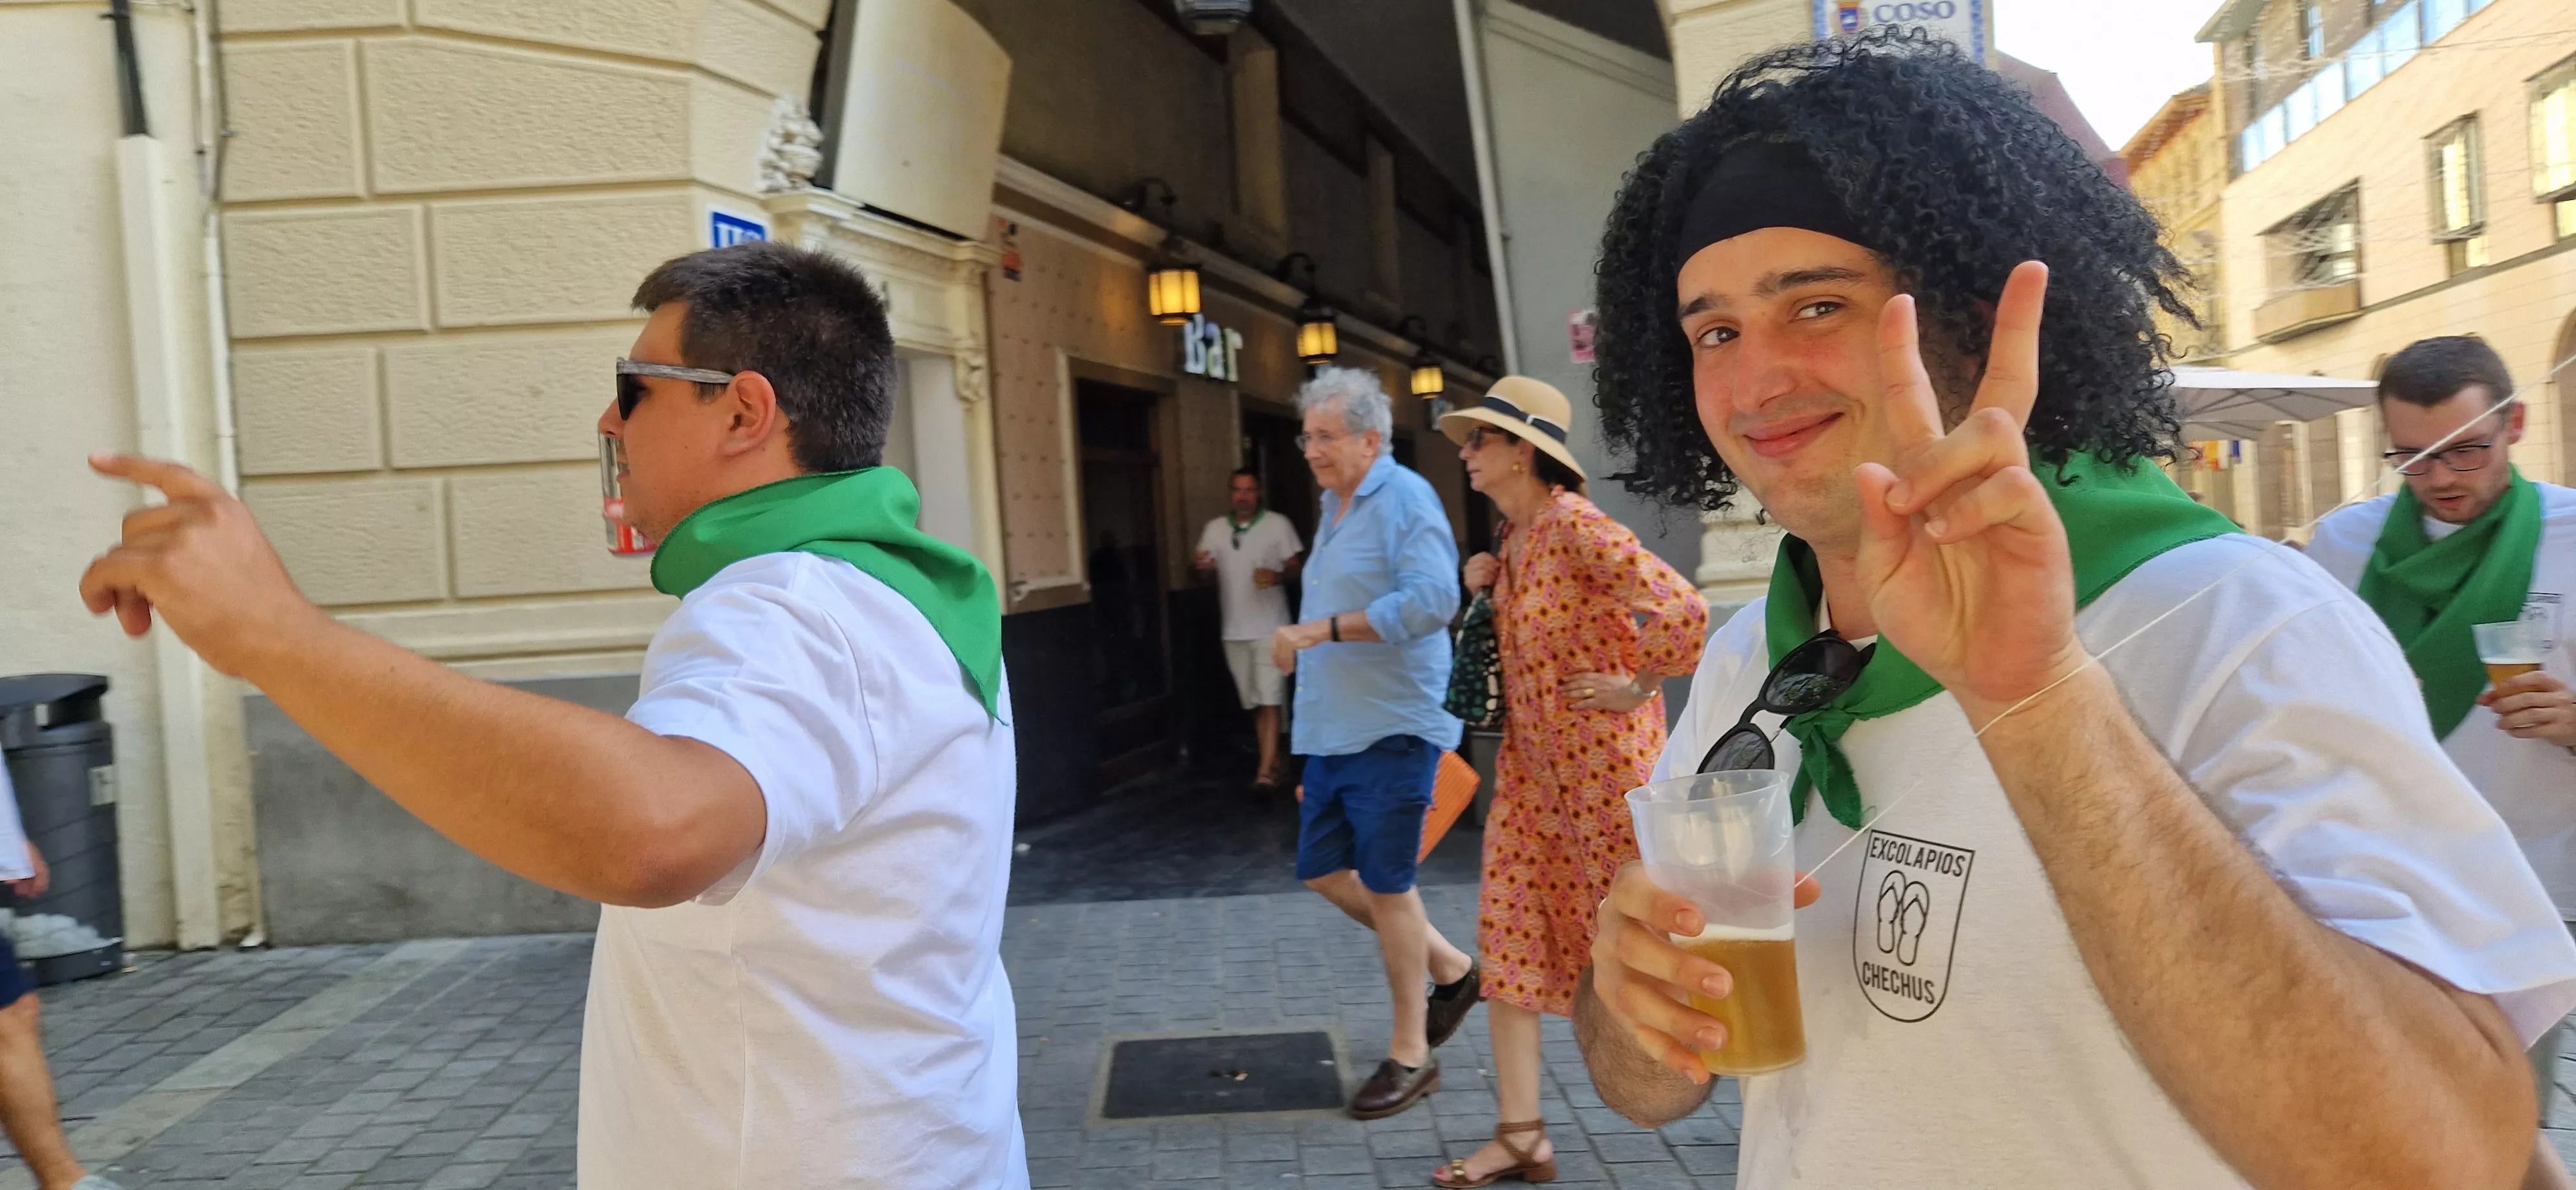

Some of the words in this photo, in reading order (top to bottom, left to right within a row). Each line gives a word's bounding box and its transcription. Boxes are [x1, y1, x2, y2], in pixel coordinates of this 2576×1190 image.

[1874, 1, 1955, 23] COSO
[1184, 314, 1243, 382] Bar
[1870, 837, 1965, 876] EXCOLAPIOS
[1862, 961, 1935, 1004] CHECHUS
